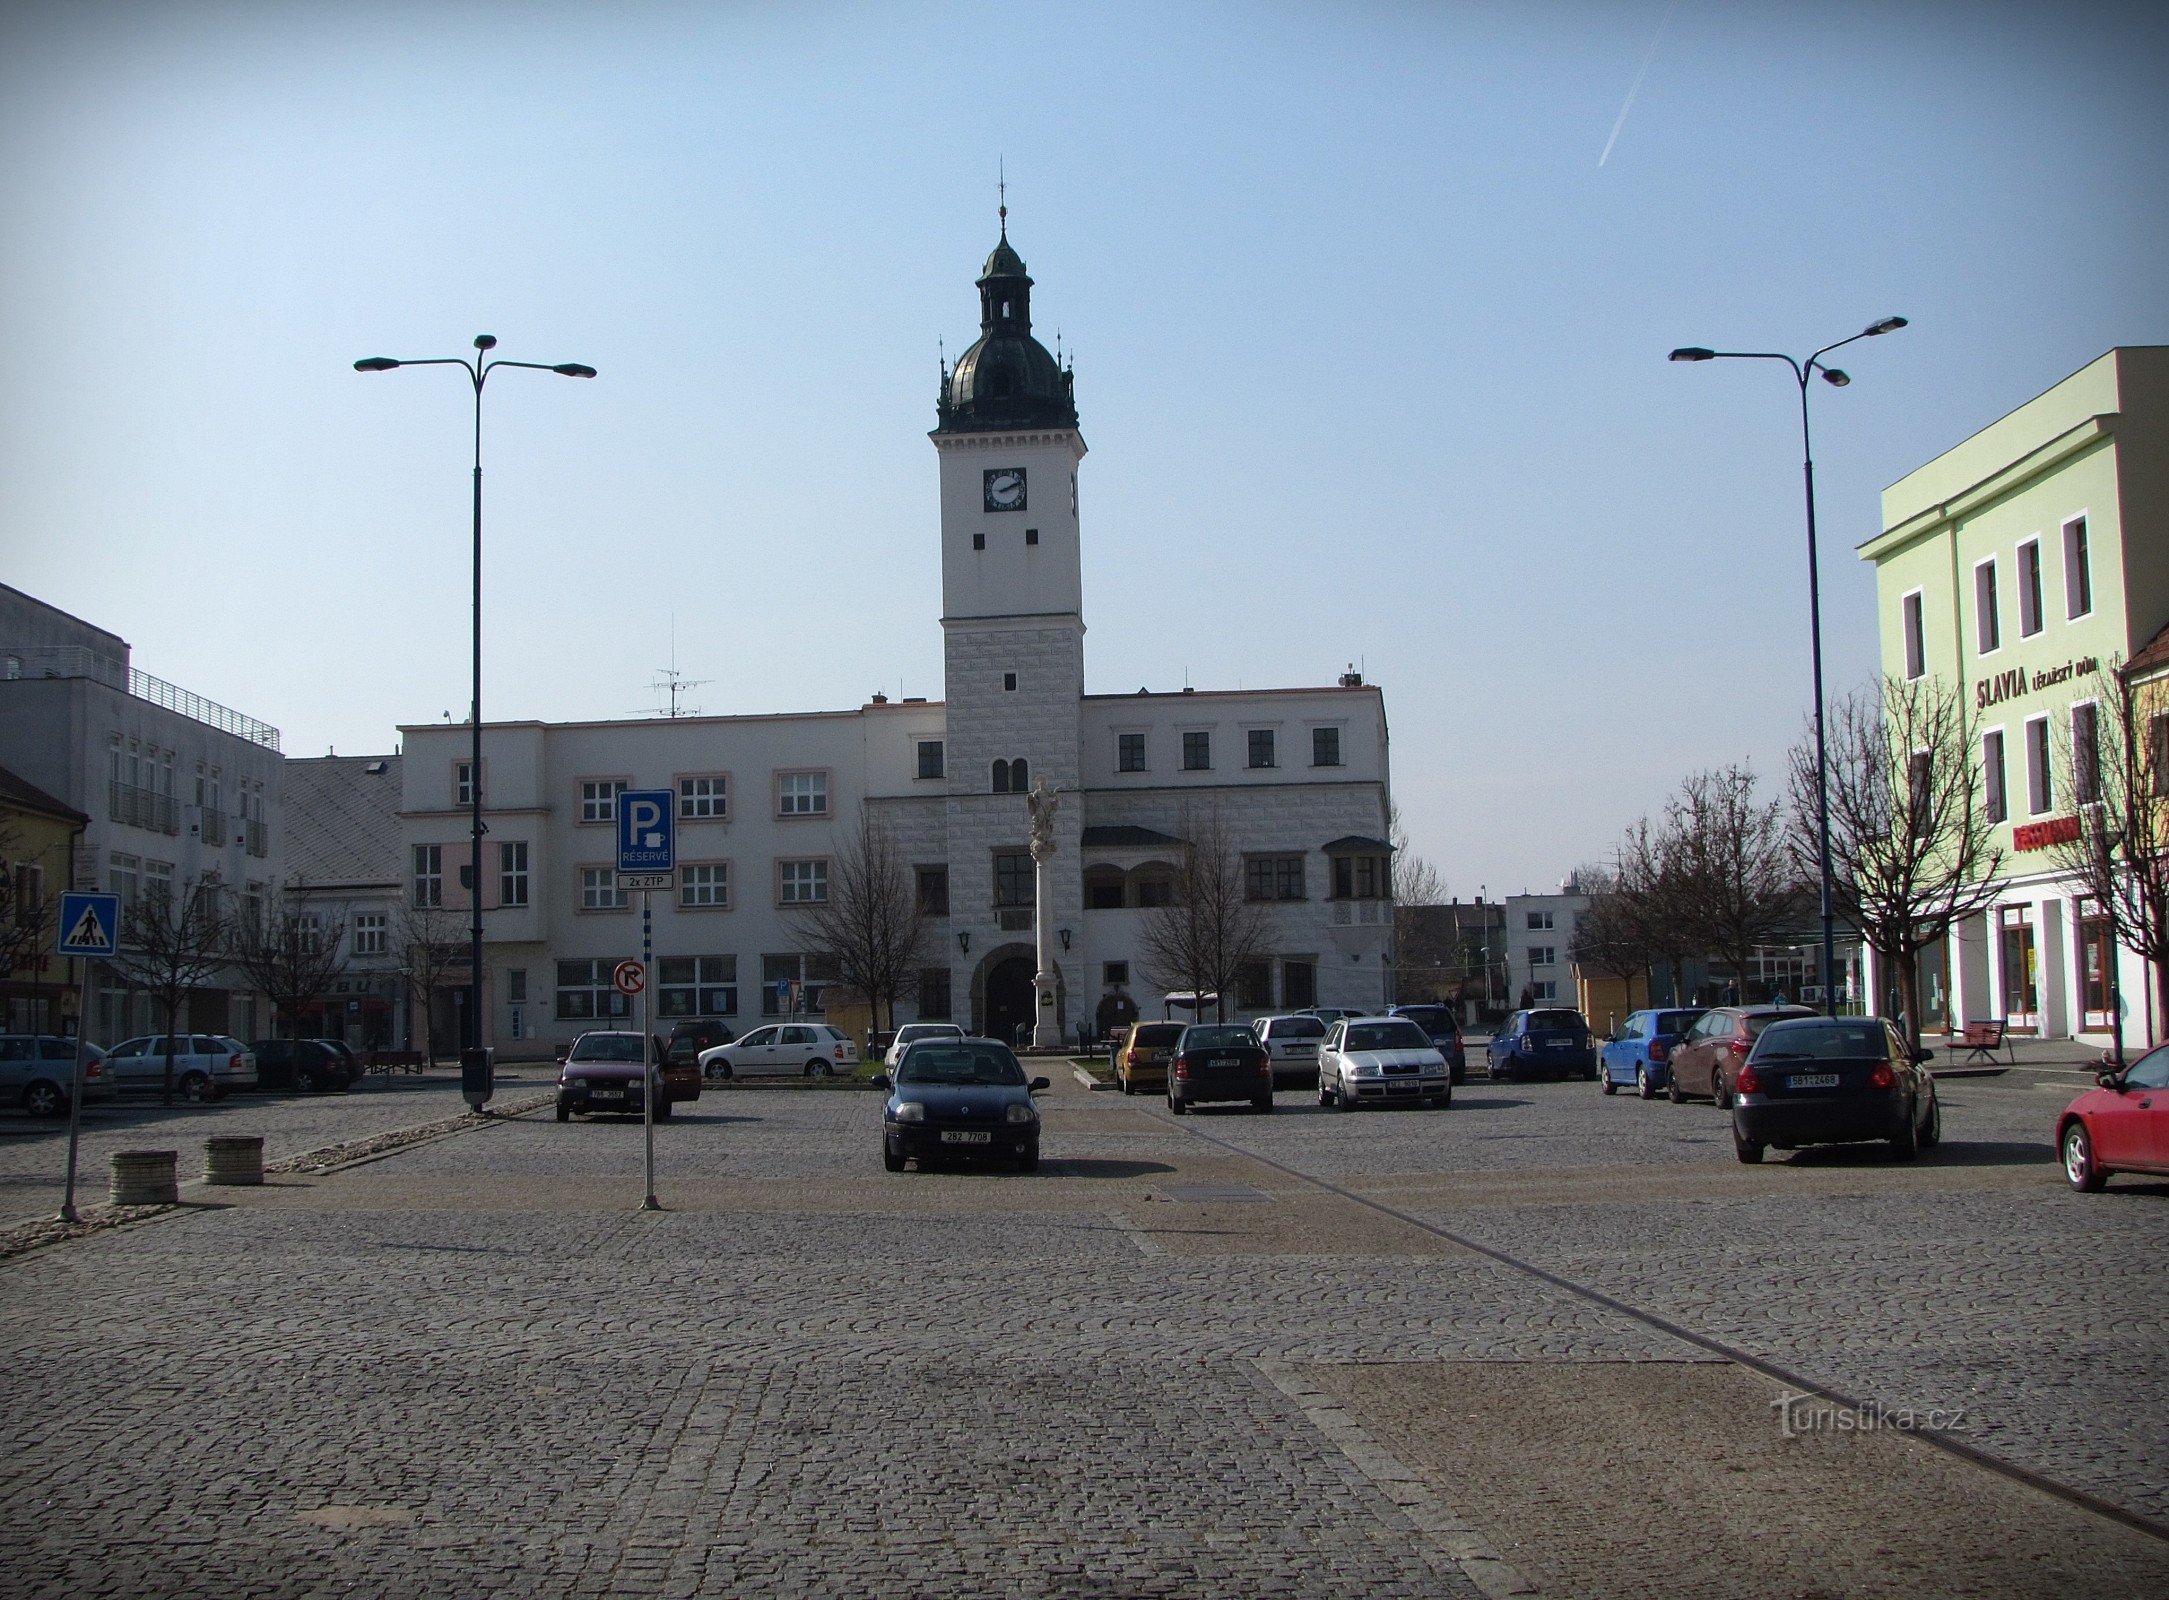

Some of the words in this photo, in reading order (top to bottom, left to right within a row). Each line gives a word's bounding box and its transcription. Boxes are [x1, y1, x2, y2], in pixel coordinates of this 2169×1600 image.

[1977, 666, 2028, 709] SLAVIA
[630, 801, 661, 846] P
[629, 877, 640, 887] 2x
[644, 877, 664, 886] ZTP
[947, 1132, 963, 1141] 2B2
[968, 1132, 988, 1141] 7708
